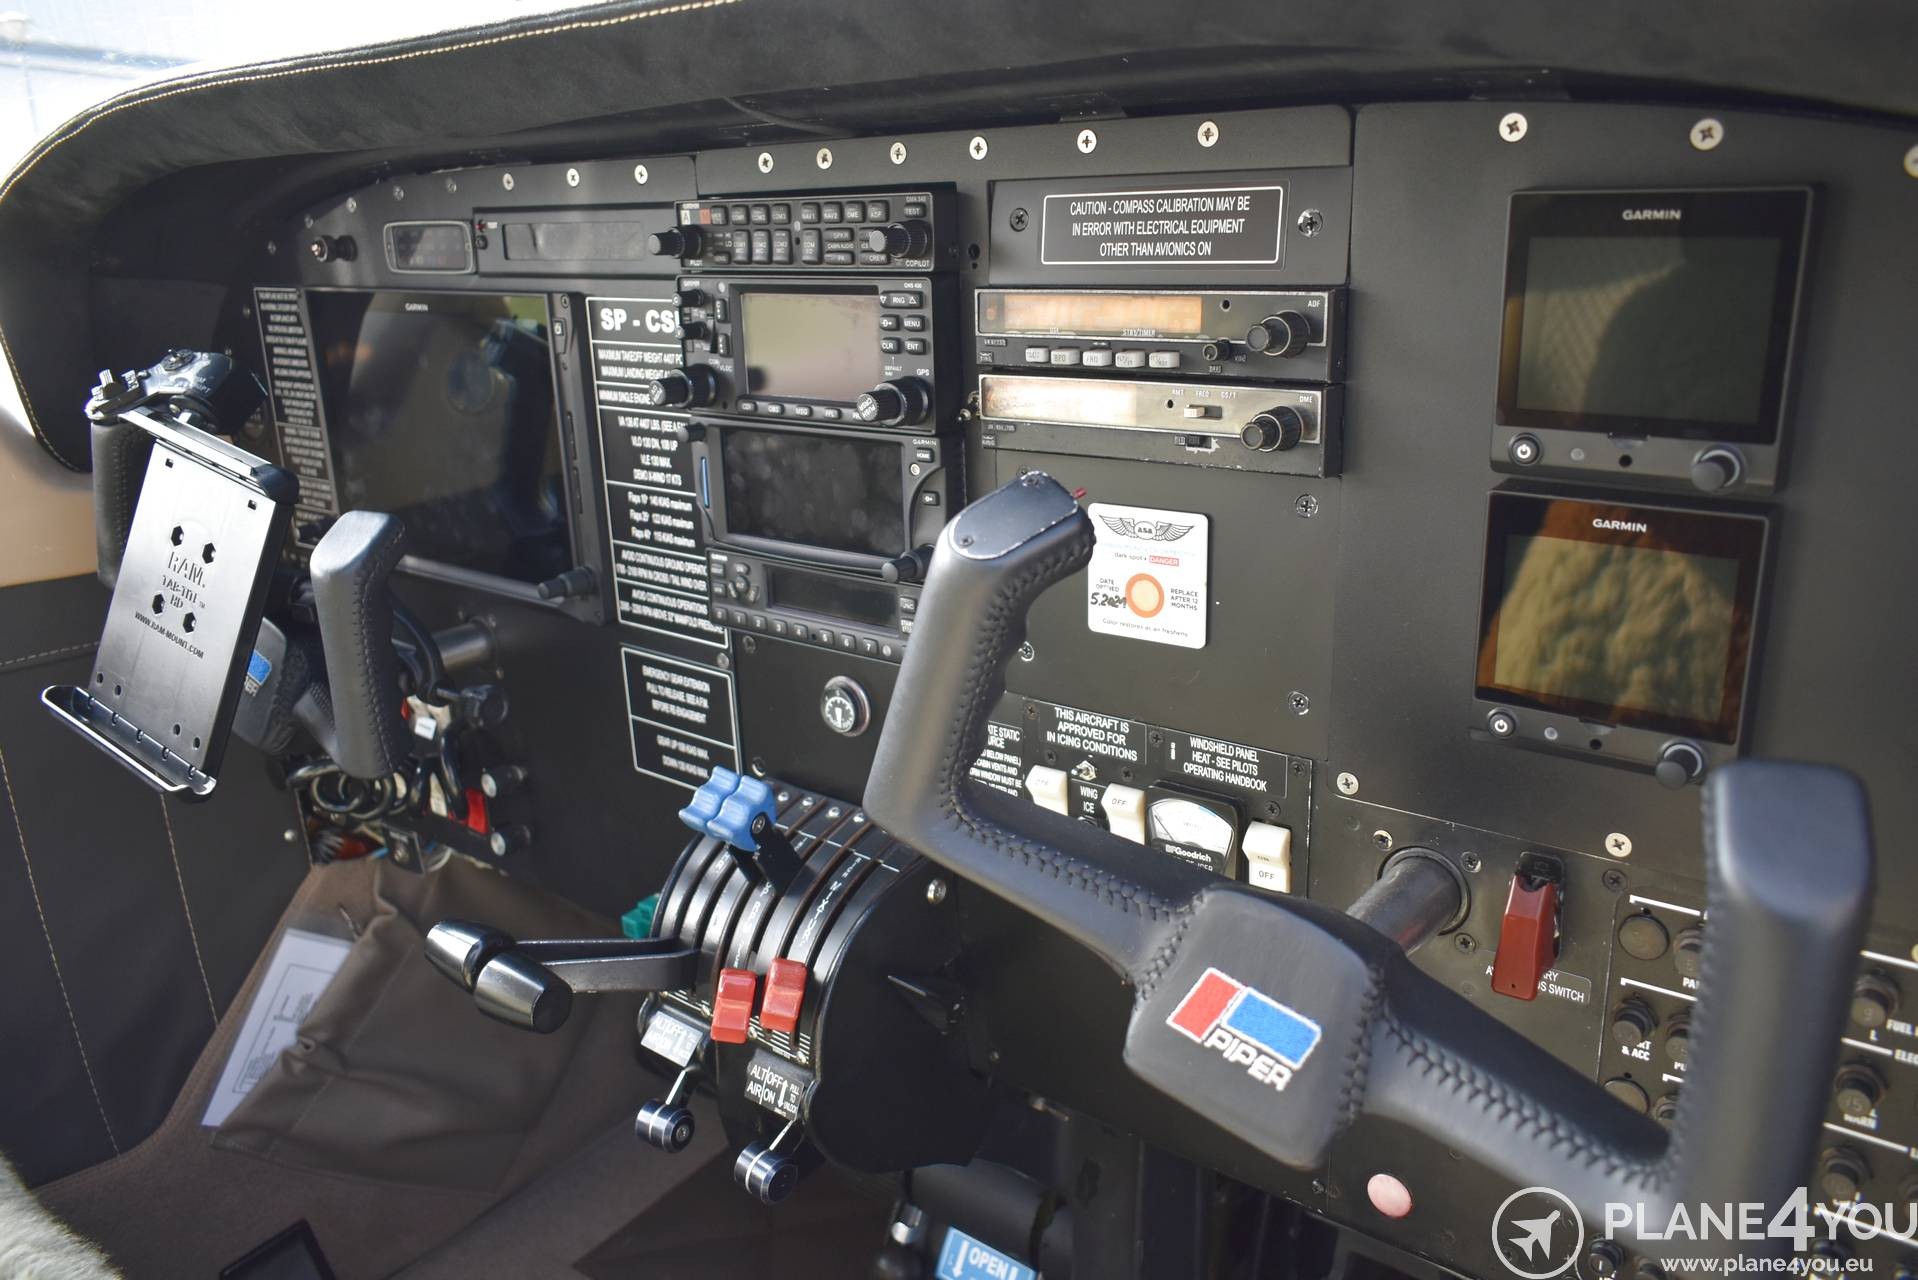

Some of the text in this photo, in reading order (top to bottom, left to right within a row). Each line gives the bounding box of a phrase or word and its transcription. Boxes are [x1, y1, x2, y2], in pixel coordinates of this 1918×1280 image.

[1070, 200, 1107, 216] CAUTION
[1113, 199, 1155, 215] COMPASS
[1156, 197, 1214, 214] CALIBRATION
[1215, 196, 1236, 212] MAY
[1237, 195, 1251, 211] BE
[1622, 208, 1681, 221] GARMIN
[1072, 218, 1245, 236] IN ERROR WITH ELECTRICAL EQUIPMENT
[1099, 241, 1212, 257] OTHER THAN AVIONICS ON
[892, 296, 905, 304] RNG
[1307, 300, 1321, 308] ADF
[600, 308, 627, 331] SP
[916, 368, 930, 376] GPS
[1299, 395, 1313, 404] DME
[1137, 526, 1153, 535] ASA
[1592, 518, 1647, 533] GARMIN
[1099, 577, 1115, 586] DATE
[1170, 588, 1199, 598] REPLACE
[1170, 596, 1190, 604] AFTER
[170, 594, 184, 609] HD
[1171, 602, 1198, 612] MONTHS
[1054, 706, 1130, 733] THIS AIRCRAFT IS
[999, 726, 1020, 742] STATIC
[1057, 721, 1126, 746] APPROVED FOR
[1046, 731, 1138, 762] IN ICING CONDITIONS
[1189, 736, 1259, 763] WINDSHIELD PANEL
[1192, 750, 1211, 764] HEAT
[1216, 757, 1231, 770] SEE
[1231, 761, 1258, 776] PILOTS
[1183, 762, 1267, 793] OPERATING HANDBOOK
[1080, 785, 1098, 800] WING
[1083, 801, 1095, 814] ICE
[1111, 798, 1127, 806] OFF
[1258, 869, 1275, 880] OFF
[1548, 982, 1585, 1003] SWITCH
[1203, 1027, 1294, 1092] PIPER
[1631, 1047, 1651, 1061] ACC
[750, 1064, 784, 1089] ALT OFF
[746, 1080, 776, 1105] AIR ON
[968, 1247, 1010, 1280] OPEN
